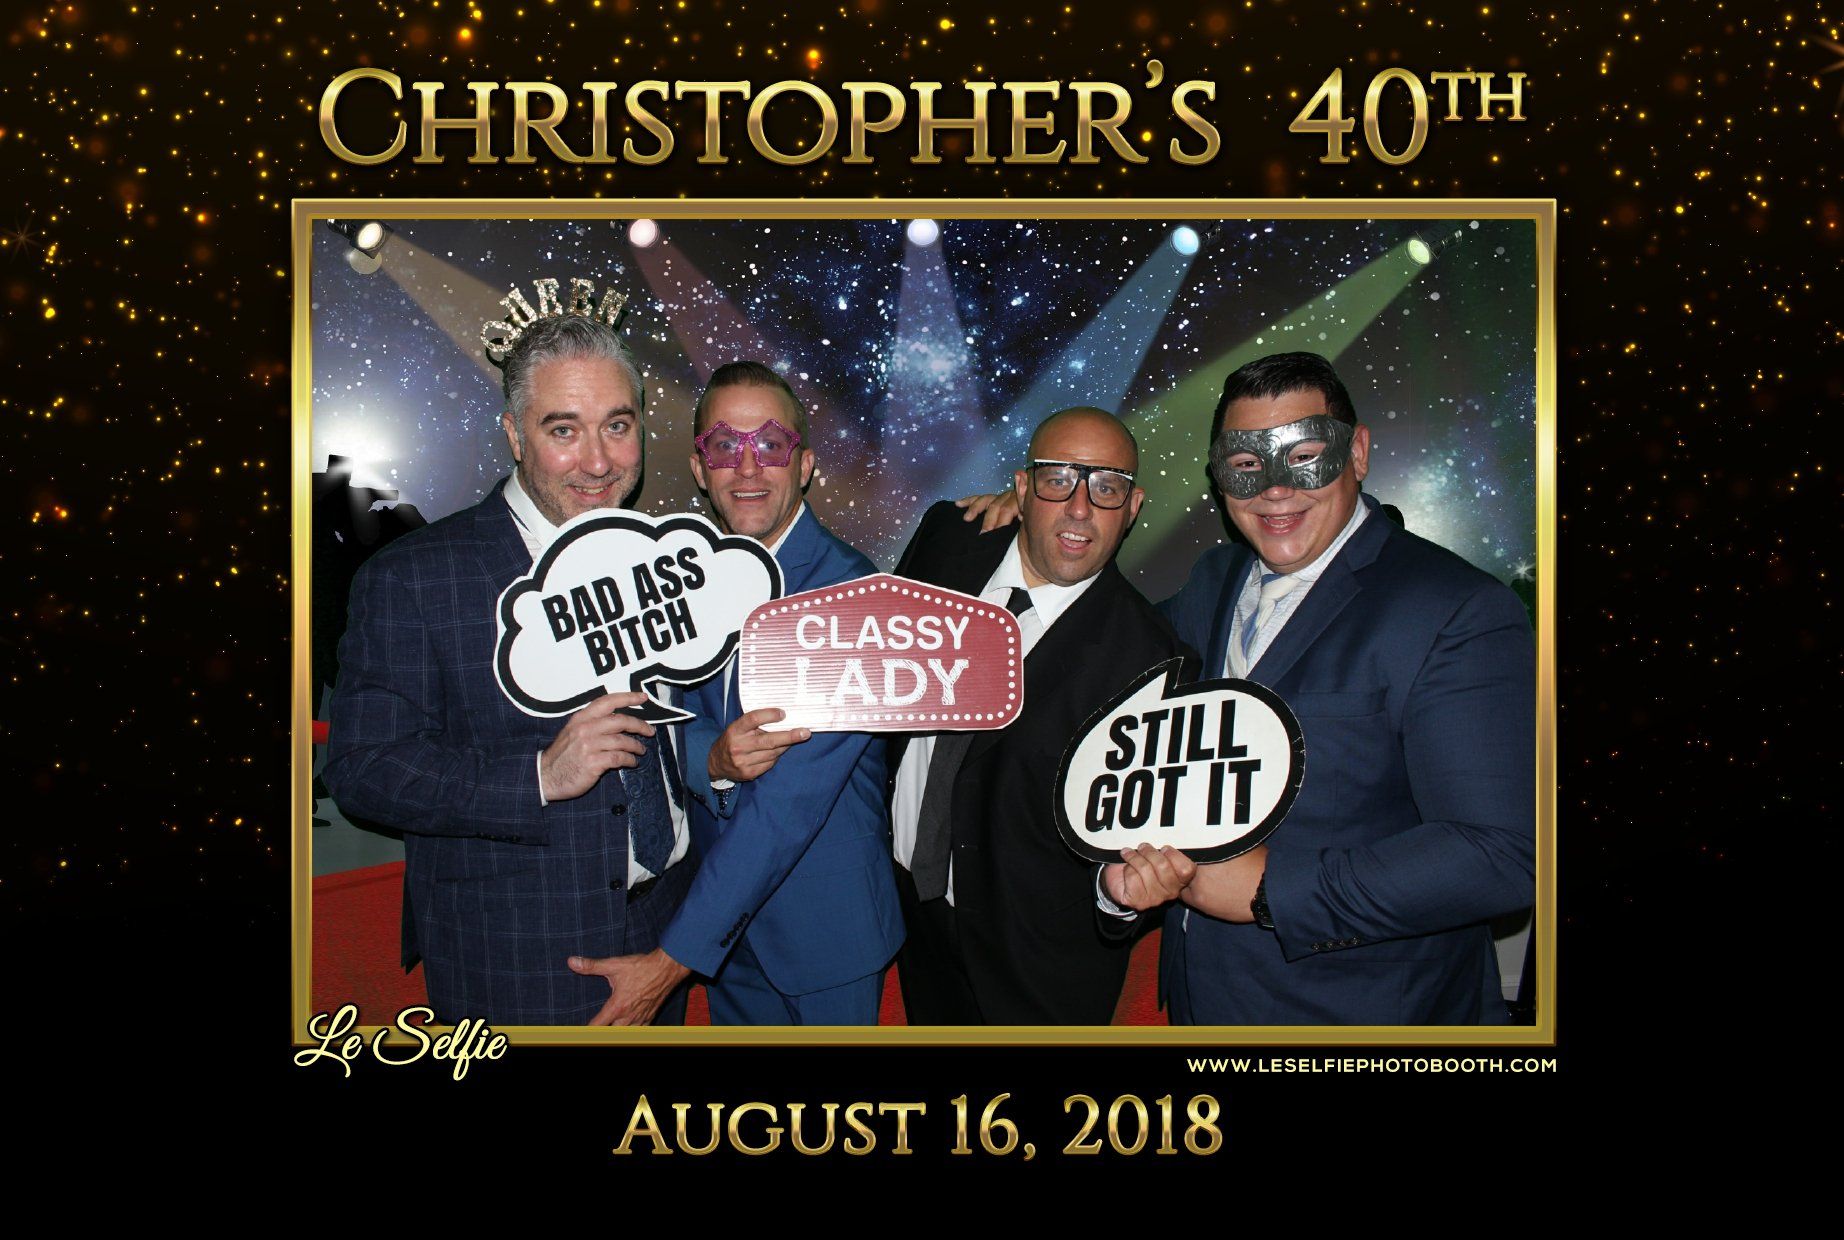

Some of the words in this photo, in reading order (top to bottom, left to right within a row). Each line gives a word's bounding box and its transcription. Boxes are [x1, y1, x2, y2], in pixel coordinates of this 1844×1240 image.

[541, 575, 625, 643] BAD
[631, 546, 706, 611] ASS
[582, 597, 698, 677] BITCH
[795, 614, 970, 650] CLASSY
[795, 658, 970, 706] LADY
[1105, 699, 1248, 771] STILL
[1084, 765, 1188, 833] GOT
[1205, 758, 1262, 826] IT
